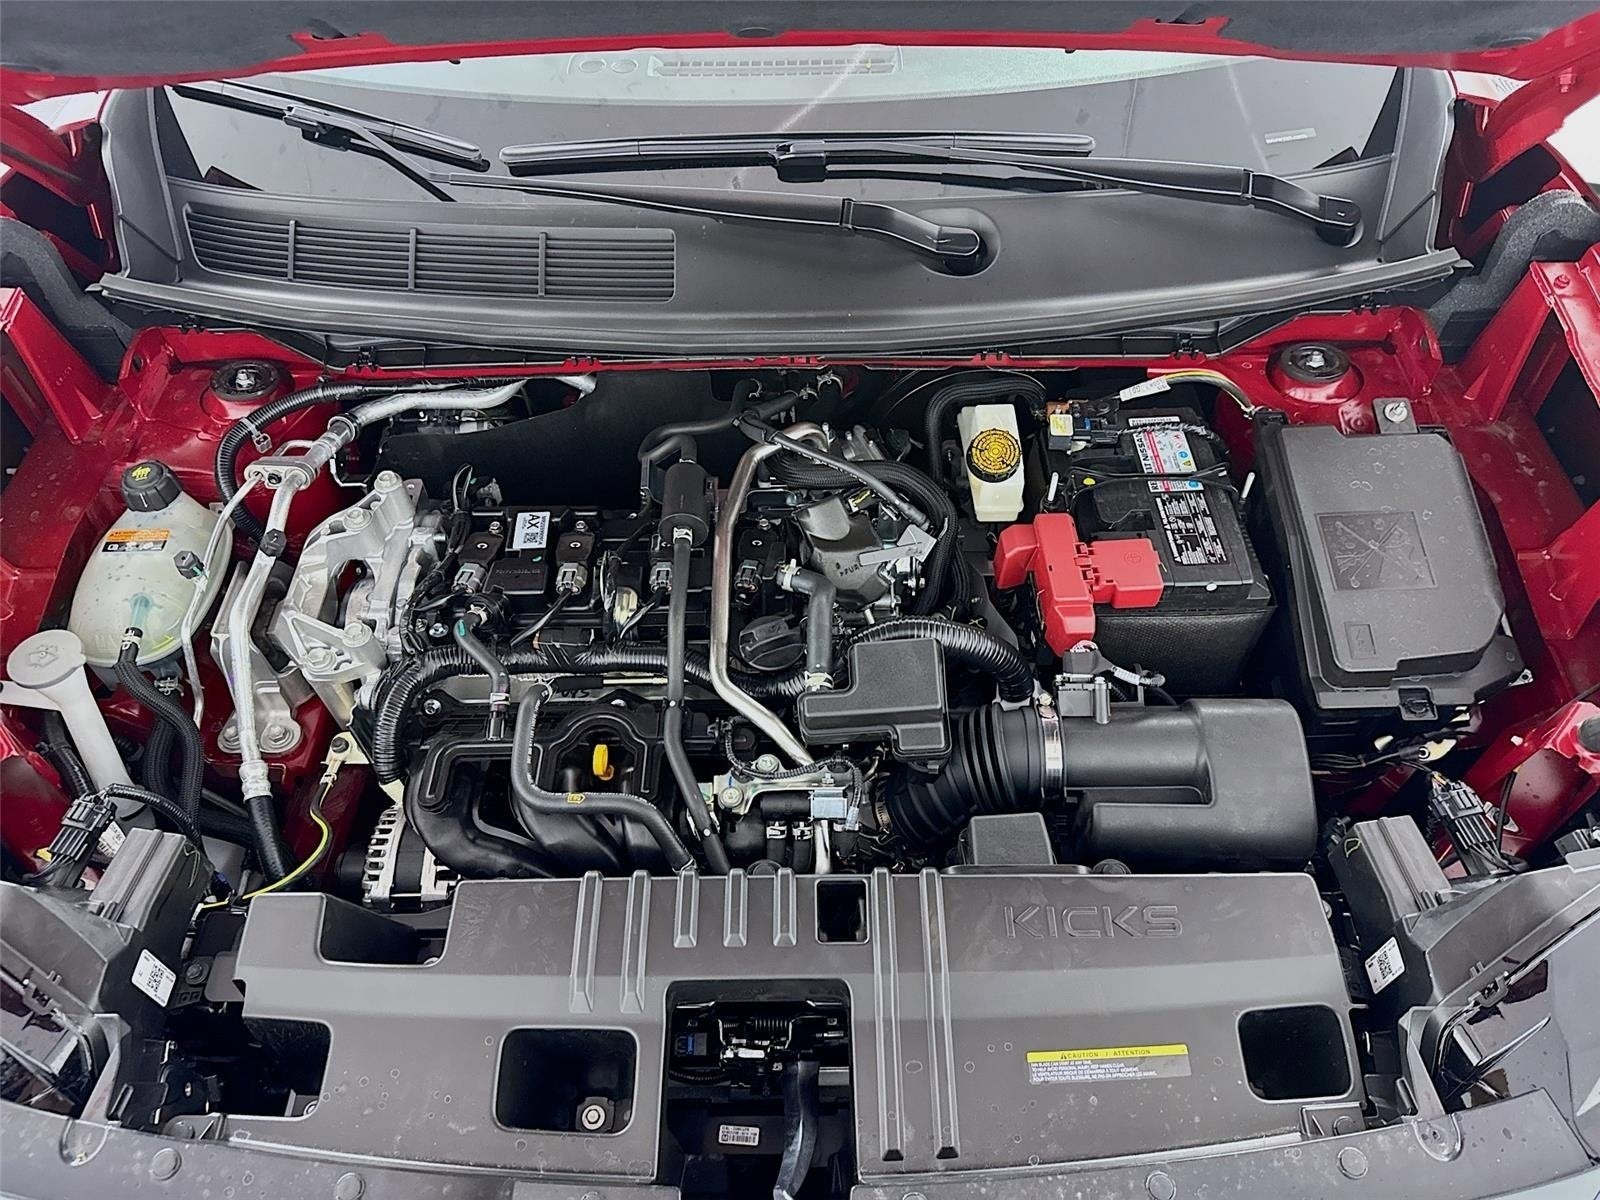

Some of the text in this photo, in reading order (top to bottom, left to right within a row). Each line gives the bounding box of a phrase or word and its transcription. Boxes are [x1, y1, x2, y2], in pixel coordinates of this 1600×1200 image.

[527, 514, 541, 529] AX
[1004, 905, 1183, 938] KICKS
[1113, 1049, 1151, 1057] ATTENTION
